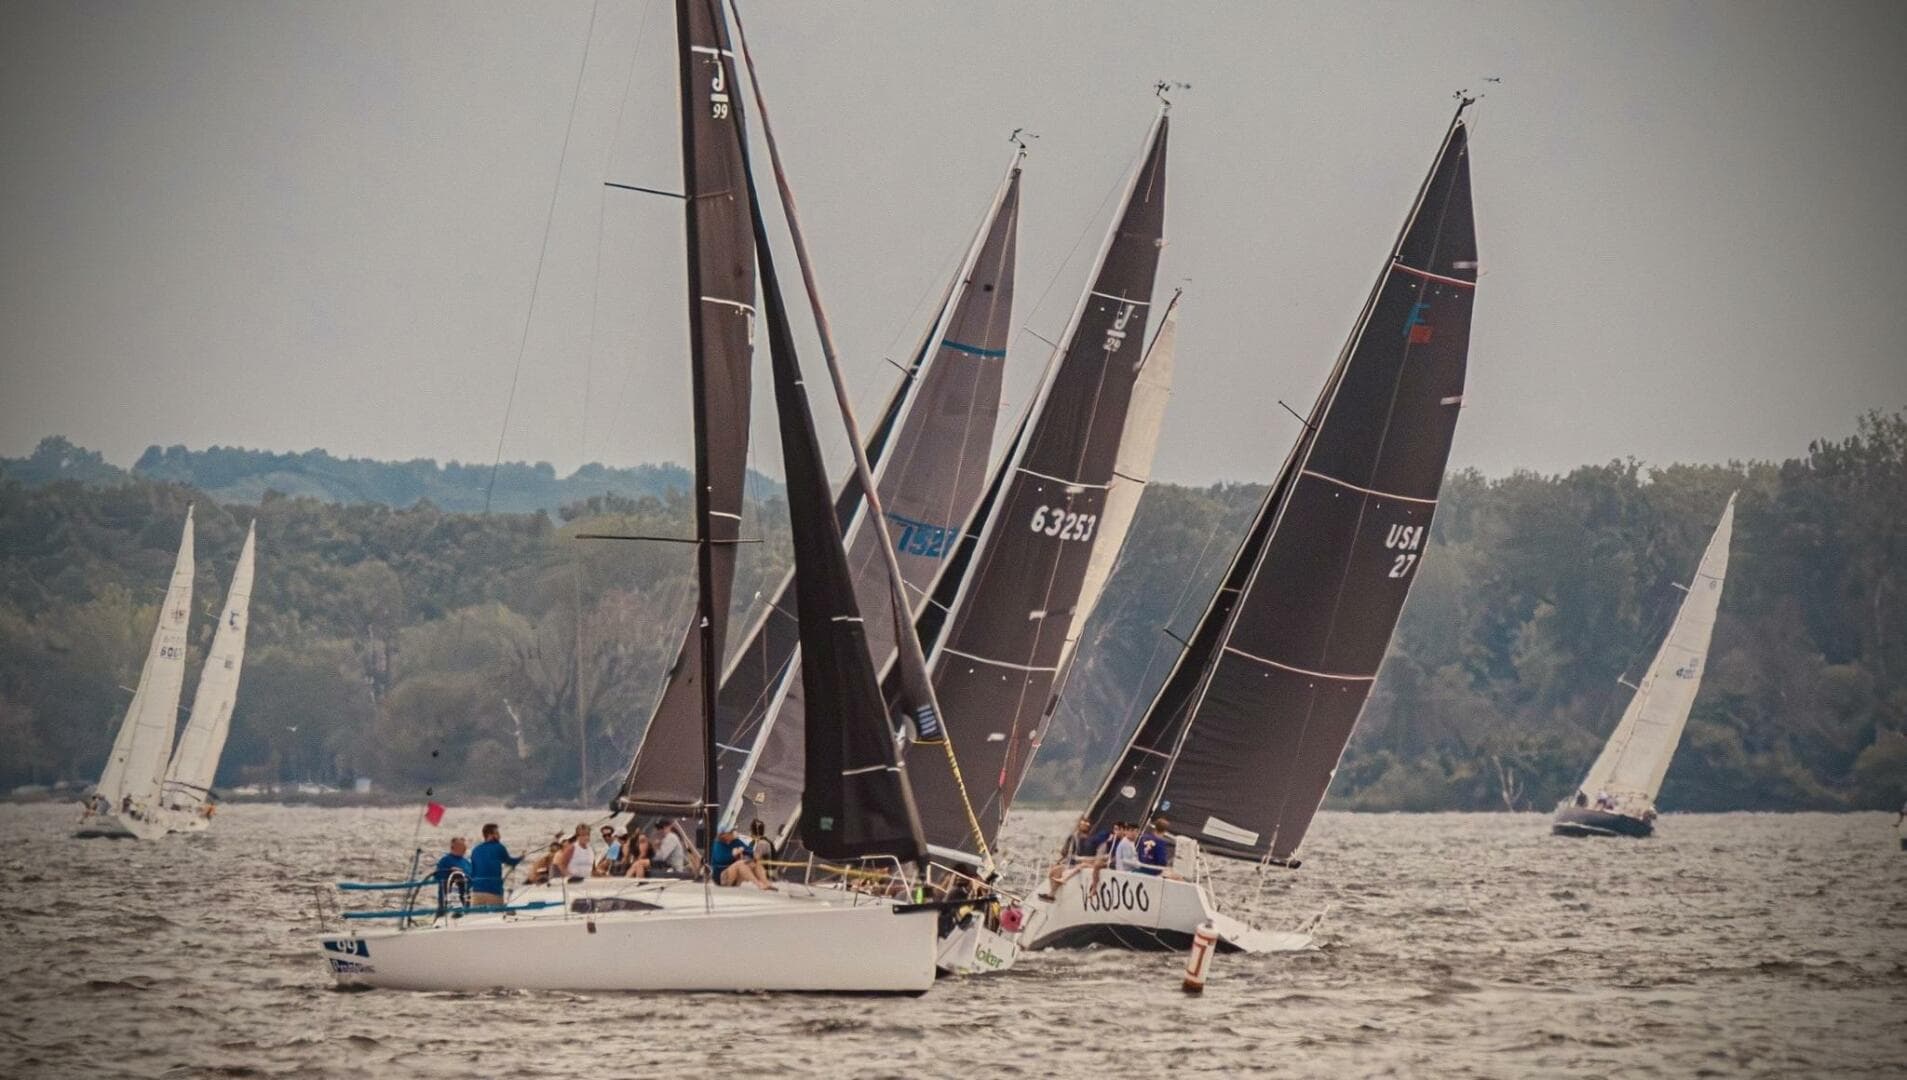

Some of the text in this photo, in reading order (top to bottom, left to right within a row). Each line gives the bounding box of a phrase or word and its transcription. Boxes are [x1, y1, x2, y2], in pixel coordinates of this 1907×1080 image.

[712, 103, 728, 119] 99
[1030, 505, 1097, 542] 63253
[1385, 524, 1424, 550] USA
[1388, 554, 1417, 578] 27
